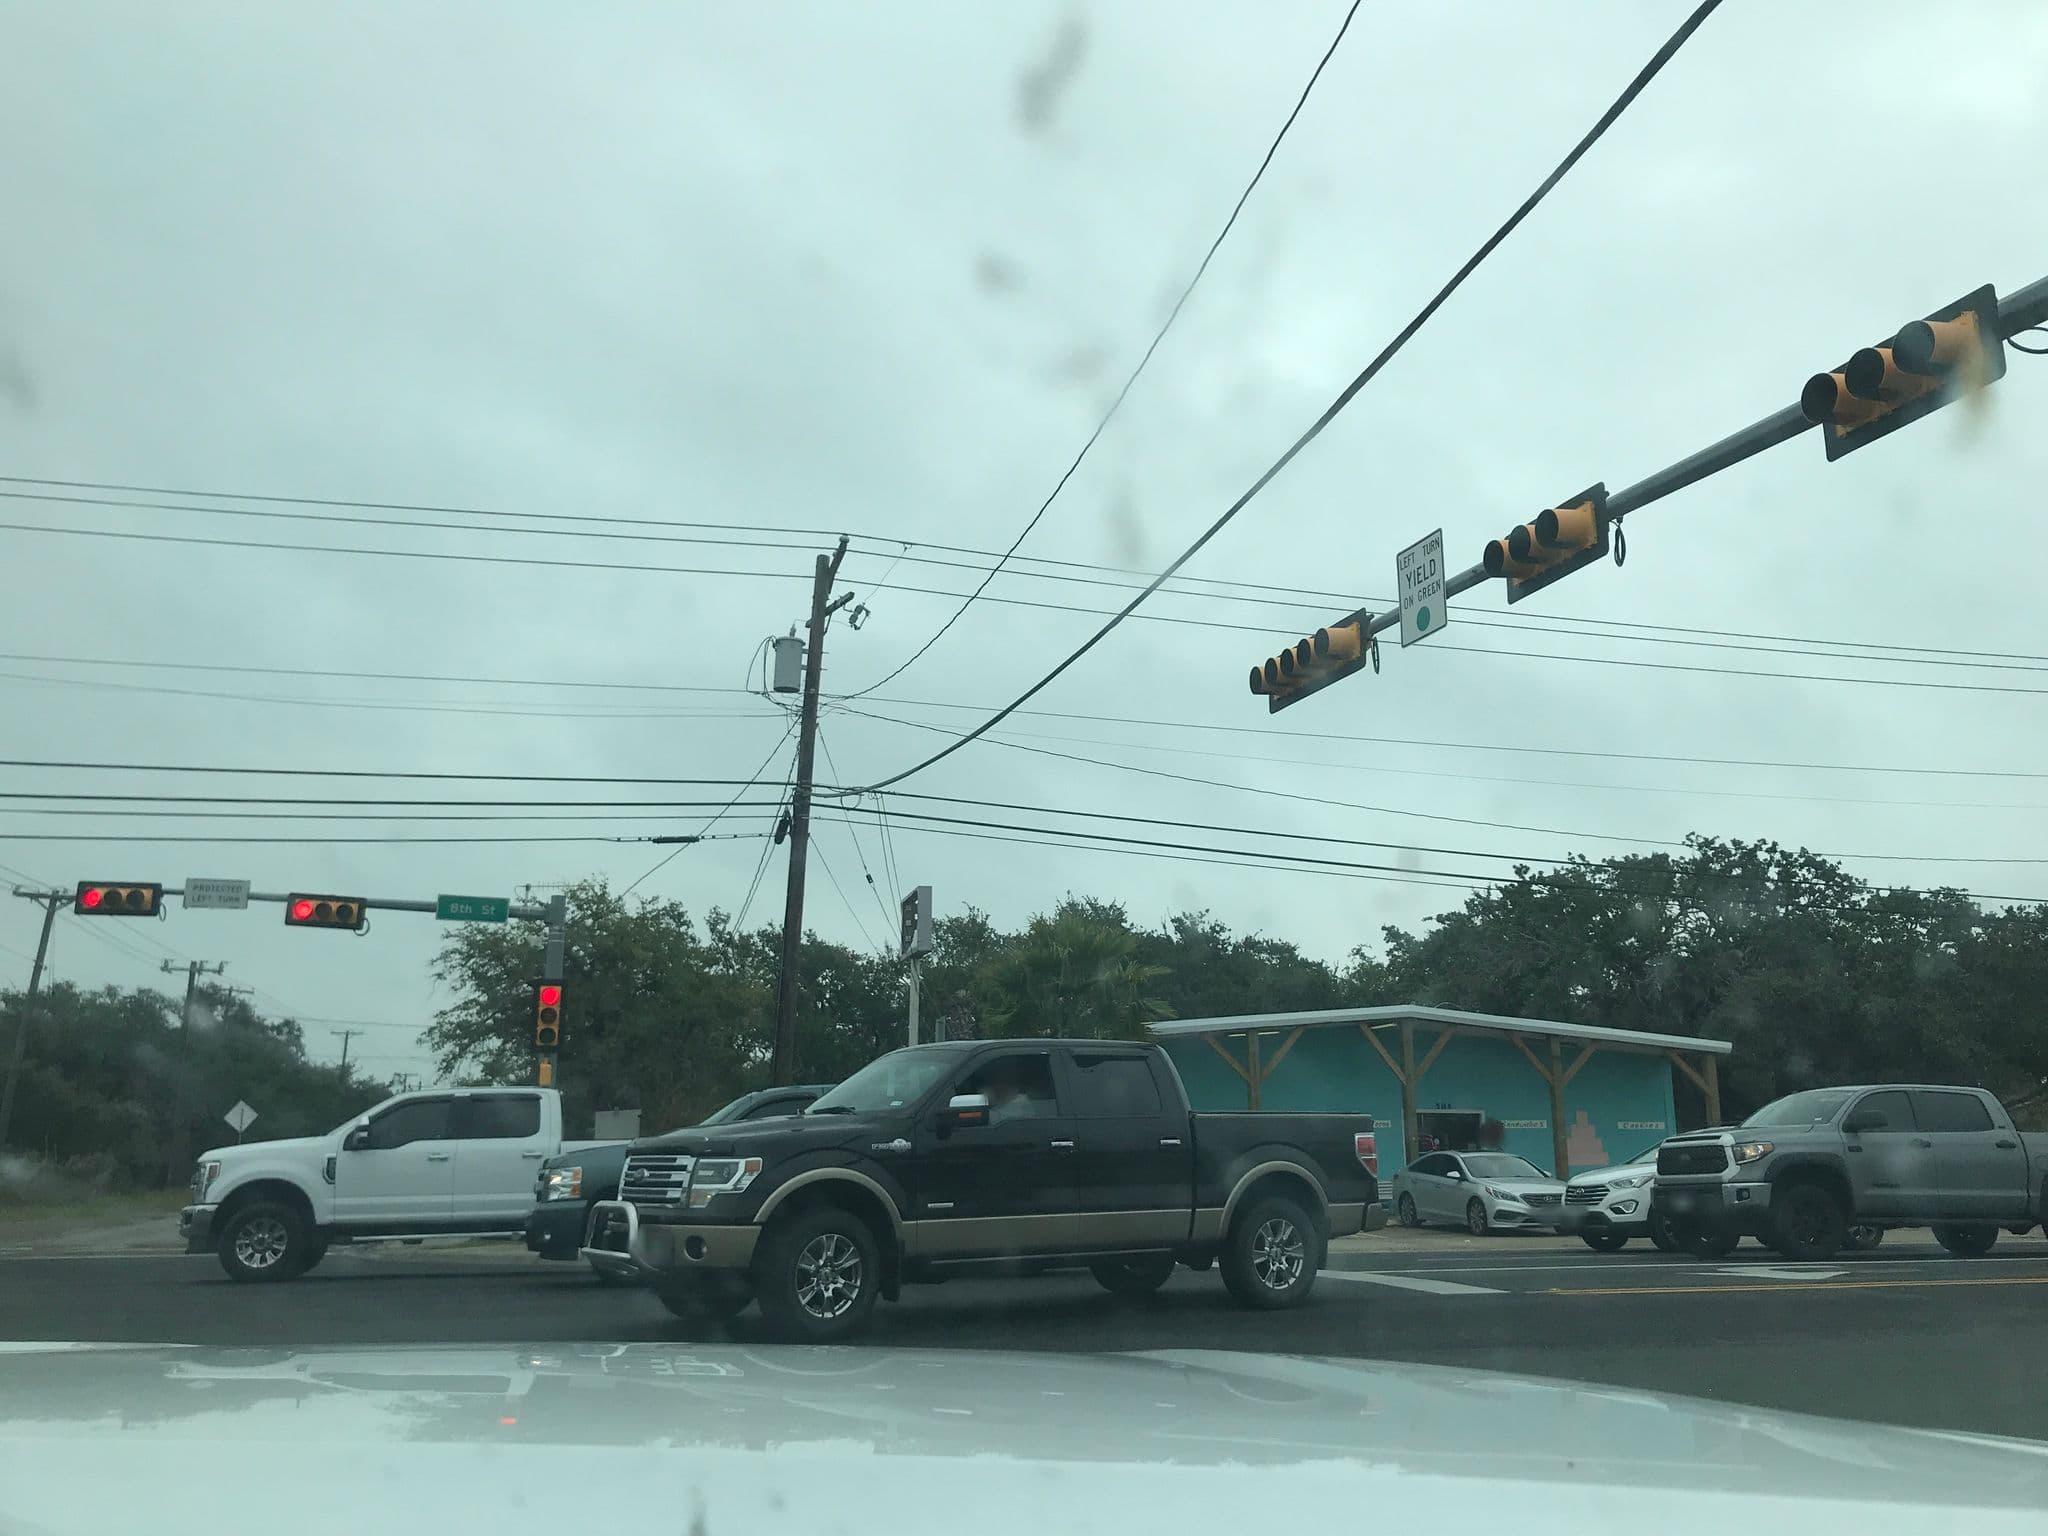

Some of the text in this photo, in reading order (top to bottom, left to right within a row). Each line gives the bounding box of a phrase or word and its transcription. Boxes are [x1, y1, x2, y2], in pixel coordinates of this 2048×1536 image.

[1400, 537, 1440, 571] LEFT TURN
[1406, 558, 1436, 589] YIELD
[1403, 579, 1441, 609] ON GREEN
[192, 884, 243, 893] PROTECTED
[191, 895, 241, 903] LEFT TURN
[481, 904, 497, 915] St
